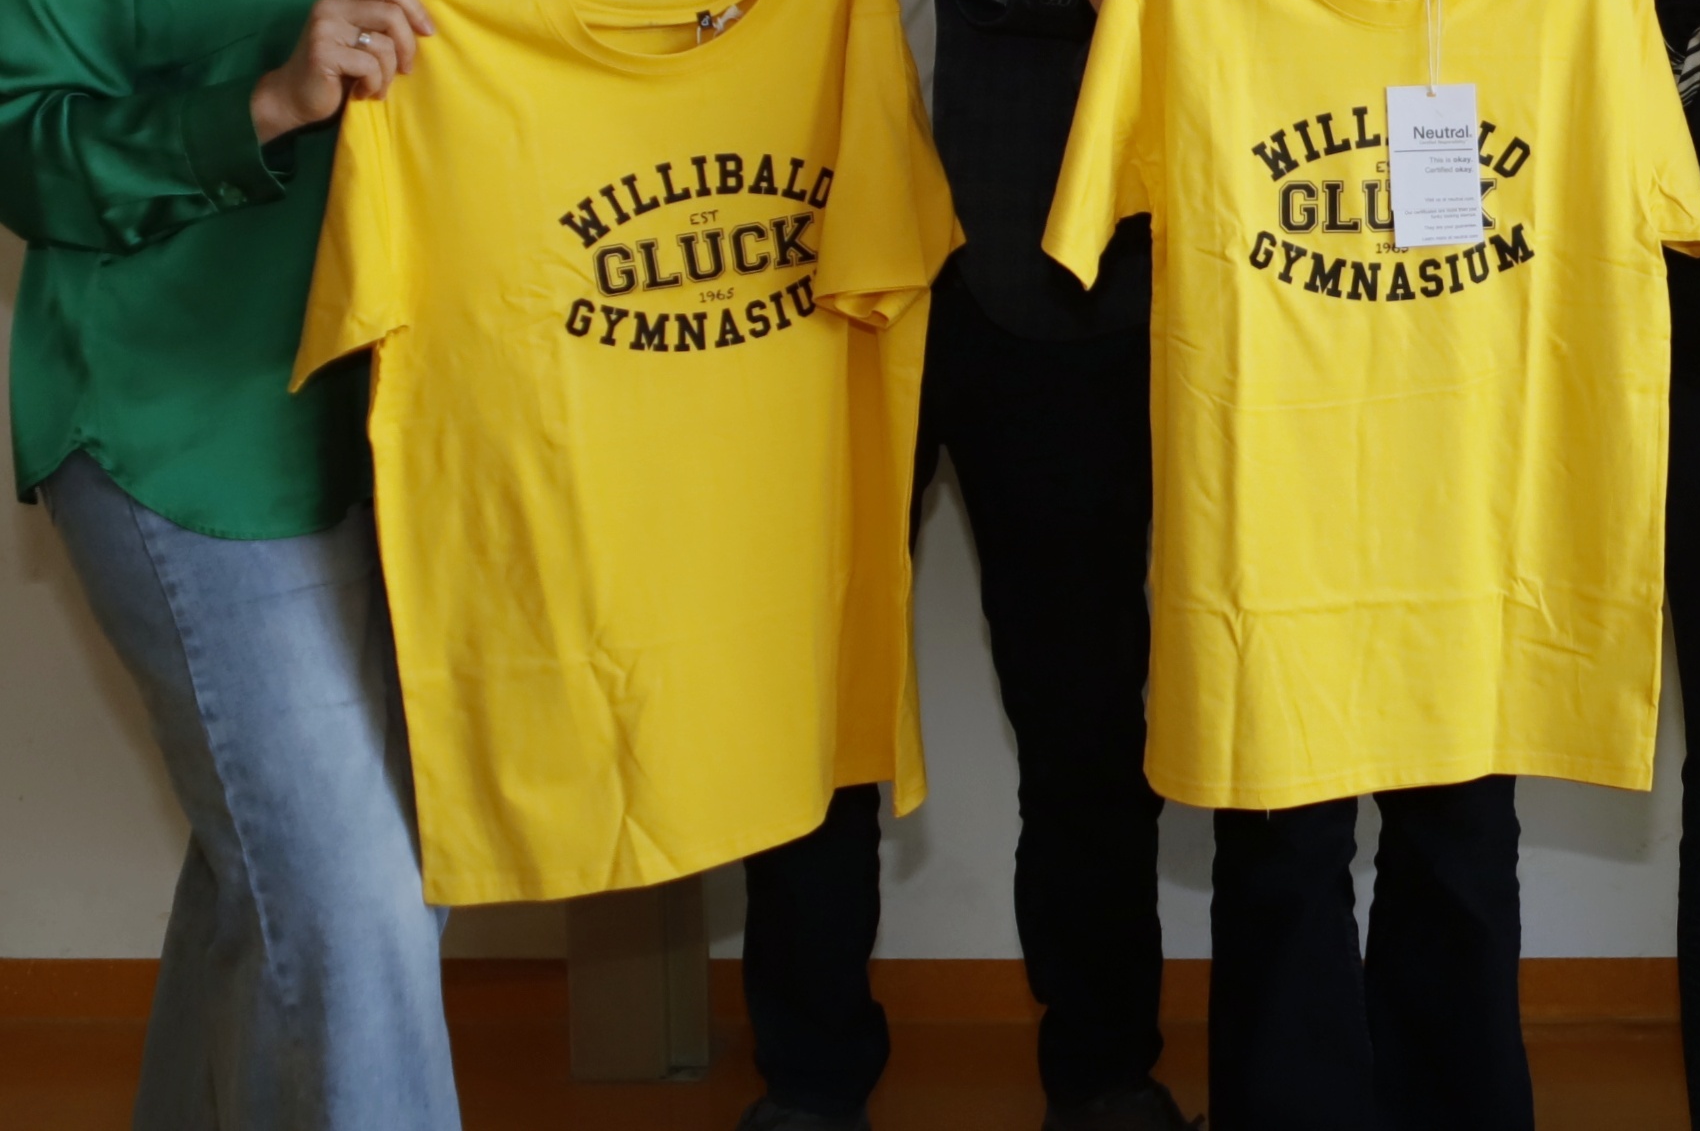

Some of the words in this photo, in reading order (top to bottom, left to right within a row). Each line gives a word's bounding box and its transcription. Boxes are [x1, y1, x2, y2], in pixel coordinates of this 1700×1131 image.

[1251, 106, 1531, 182] WILLLD
[558, 152, 834, 249] WILLIBALD
[689, 209, 719, 226] EST
[592, 211, 818, 297] GLUCK
[1249, 223, 1535, 302] GYMNASIUM
[565, 270, 817, 352] GYMNASIU
[699, 287, 735, 304] 1965
